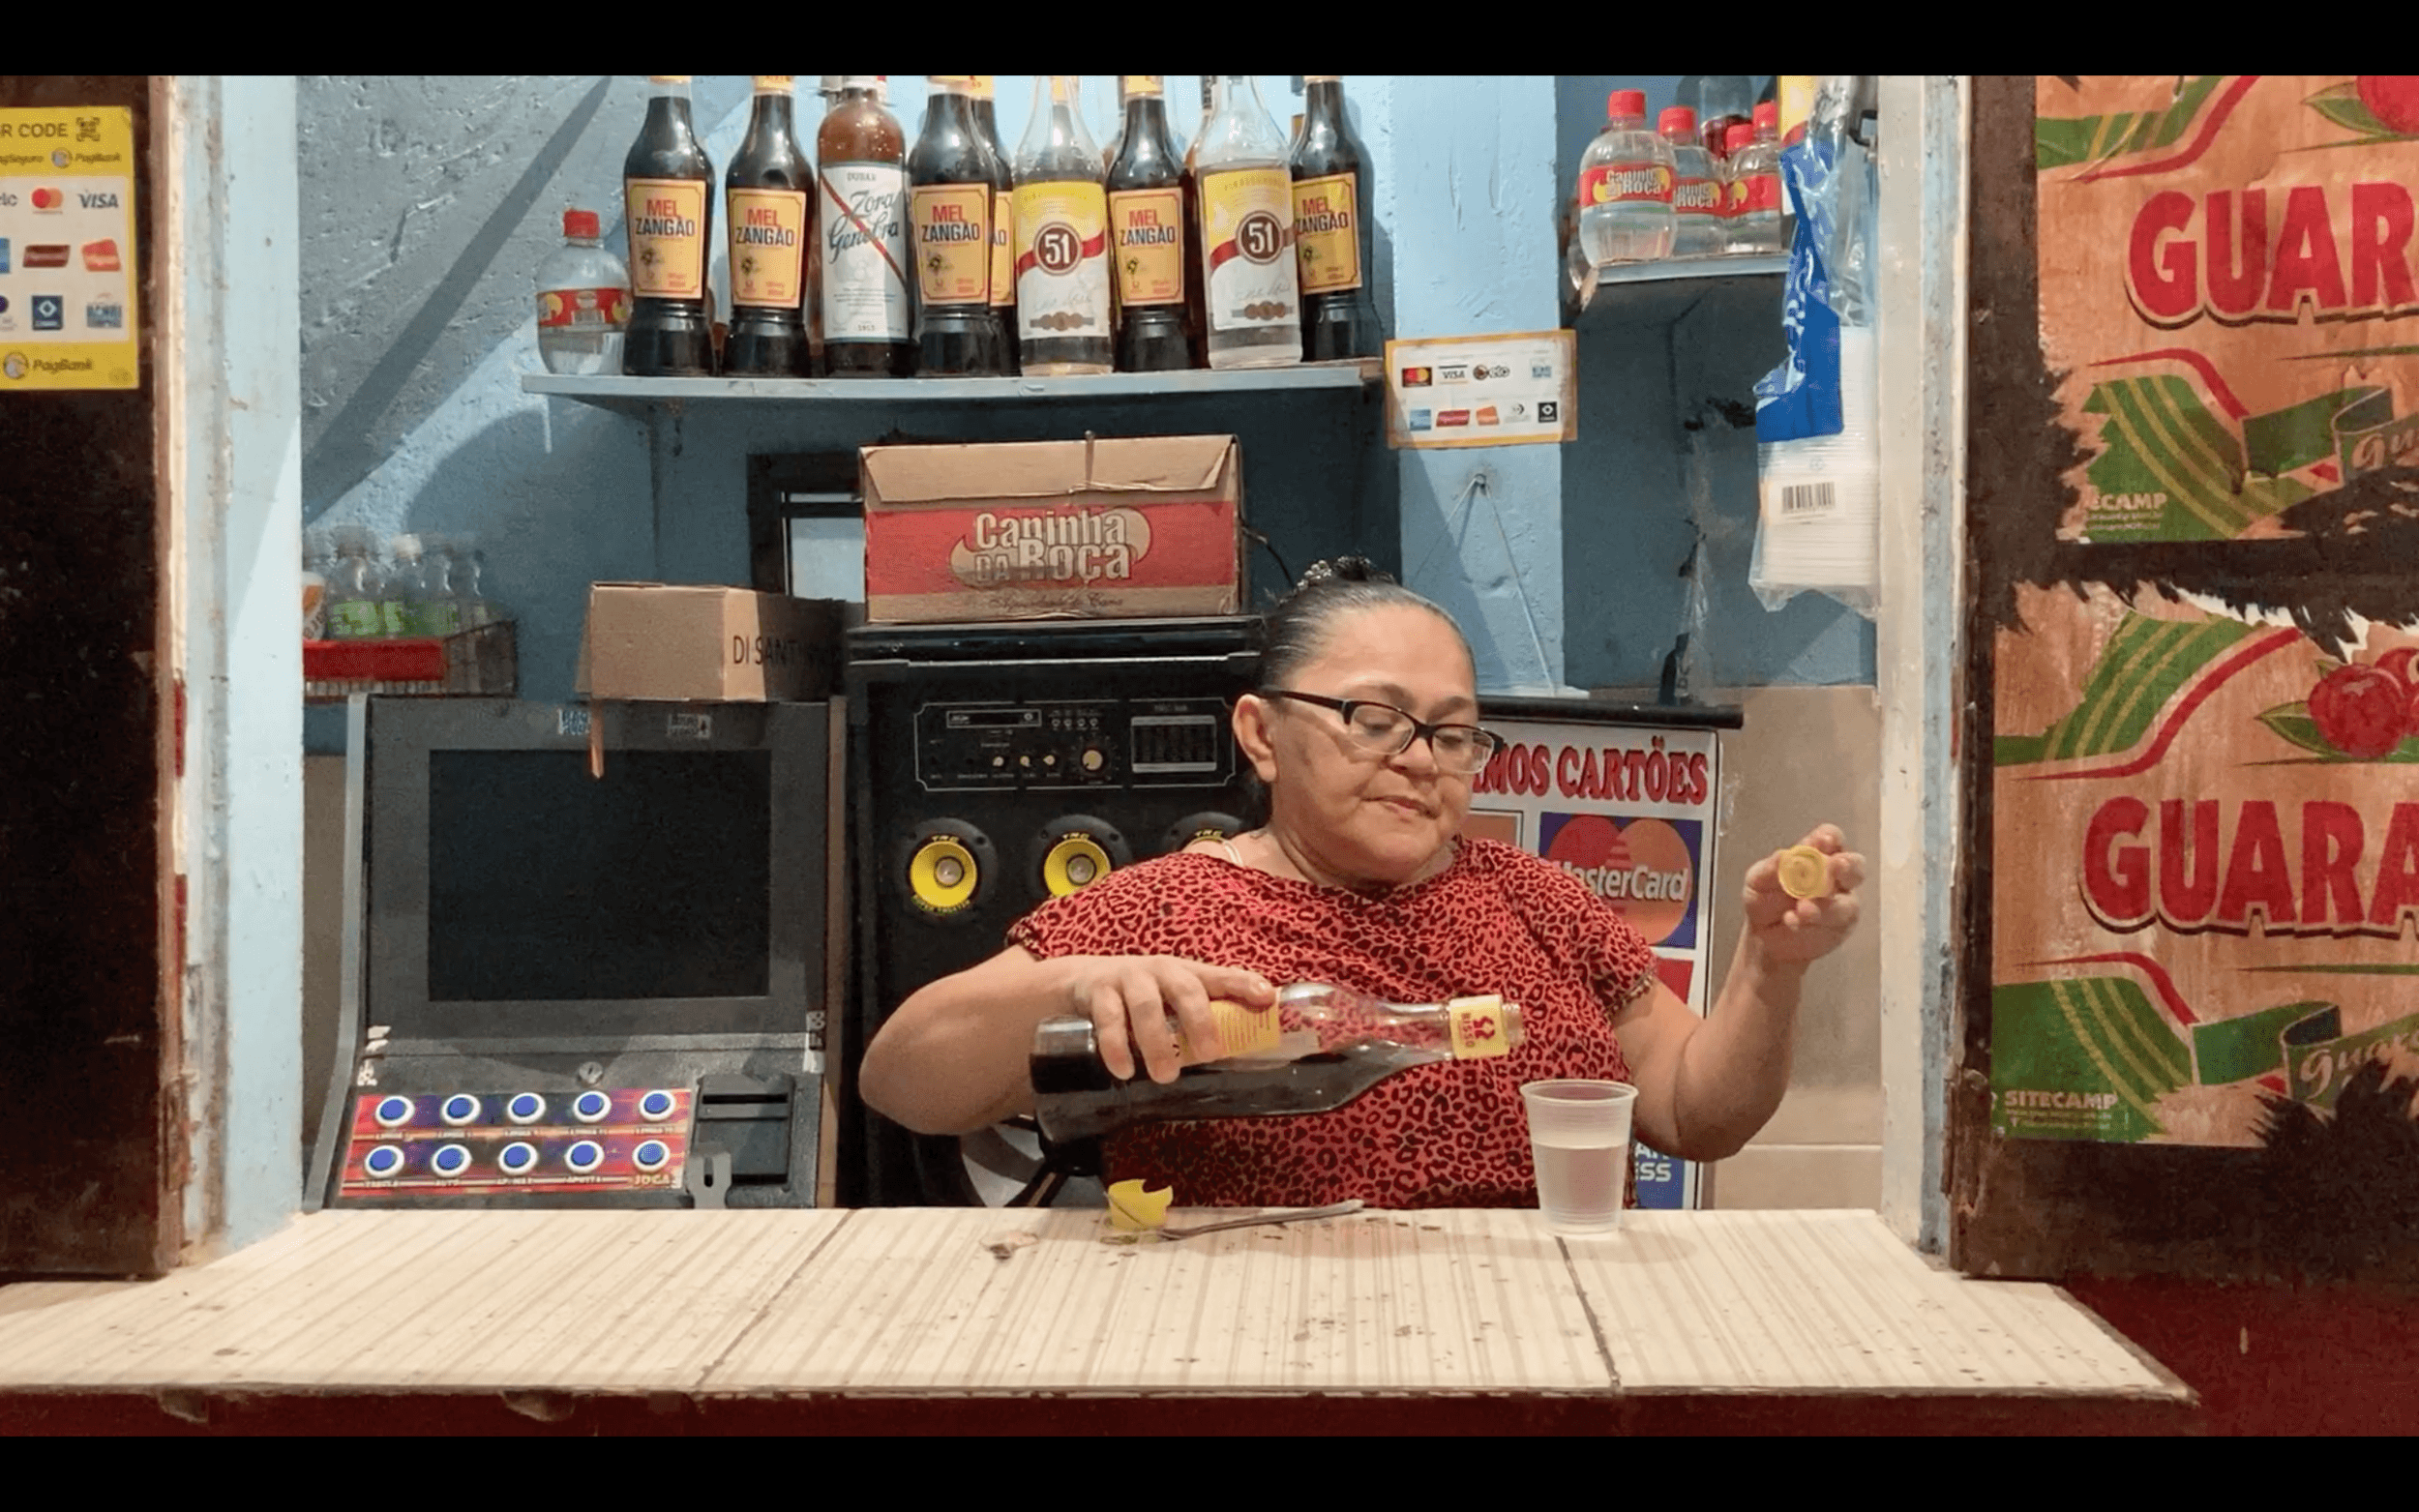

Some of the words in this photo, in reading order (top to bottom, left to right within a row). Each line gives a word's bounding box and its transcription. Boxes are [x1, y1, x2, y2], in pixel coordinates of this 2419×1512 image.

[18, 123, 69, 137] CODE
[77, 193, 119, 208] VISA
[646, 199, 678, 217] MEL
[851, 191, 894, 221] Zora
[1301, 196, 1329, 215] MEL
[747, 209, 780, 226] MEL
[932, 204, 965, 222] MEL
[1128, 209, 1158, 227] MEL
[1248, 222, 1274, 253] 51
[1044, 233, 1070, 264] 51
[2128, 182, 2419, 323] GUAR
[1442, 370, 1466, 379] VISA
[975, 510, 1128, 550] Caninha
[973, 553, 1010, 581] DA
[732, 635, 750, 665] DI
[1473, 744, 1551, 796] MOS
[1556, 735, 1709, 806] CARTÕES
[2005, 1090, 2119, 1111] SITECAMP
